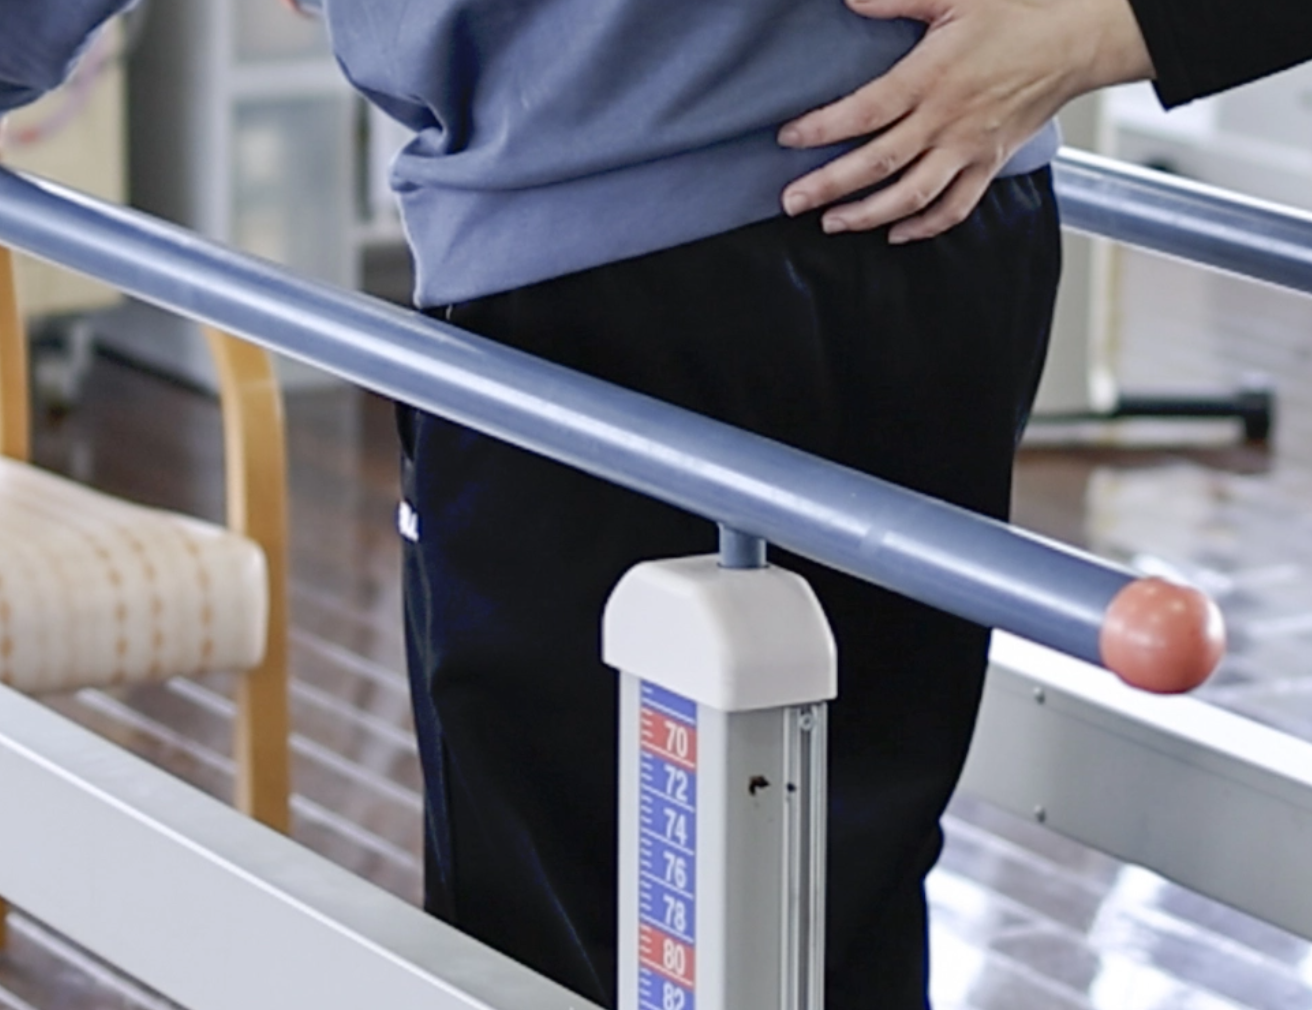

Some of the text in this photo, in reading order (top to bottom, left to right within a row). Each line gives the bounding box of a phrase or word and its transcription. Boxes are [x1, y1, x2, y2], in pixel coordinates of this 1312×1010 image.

[664, 721, 687, 756] 70
[664, 764, 688, 802] 72
[664, 809, 687, 844] 74
[664, 852, 687, 888] 76
[663, 895, 686, 931] 78
[663, 939, 685, 976] 80
